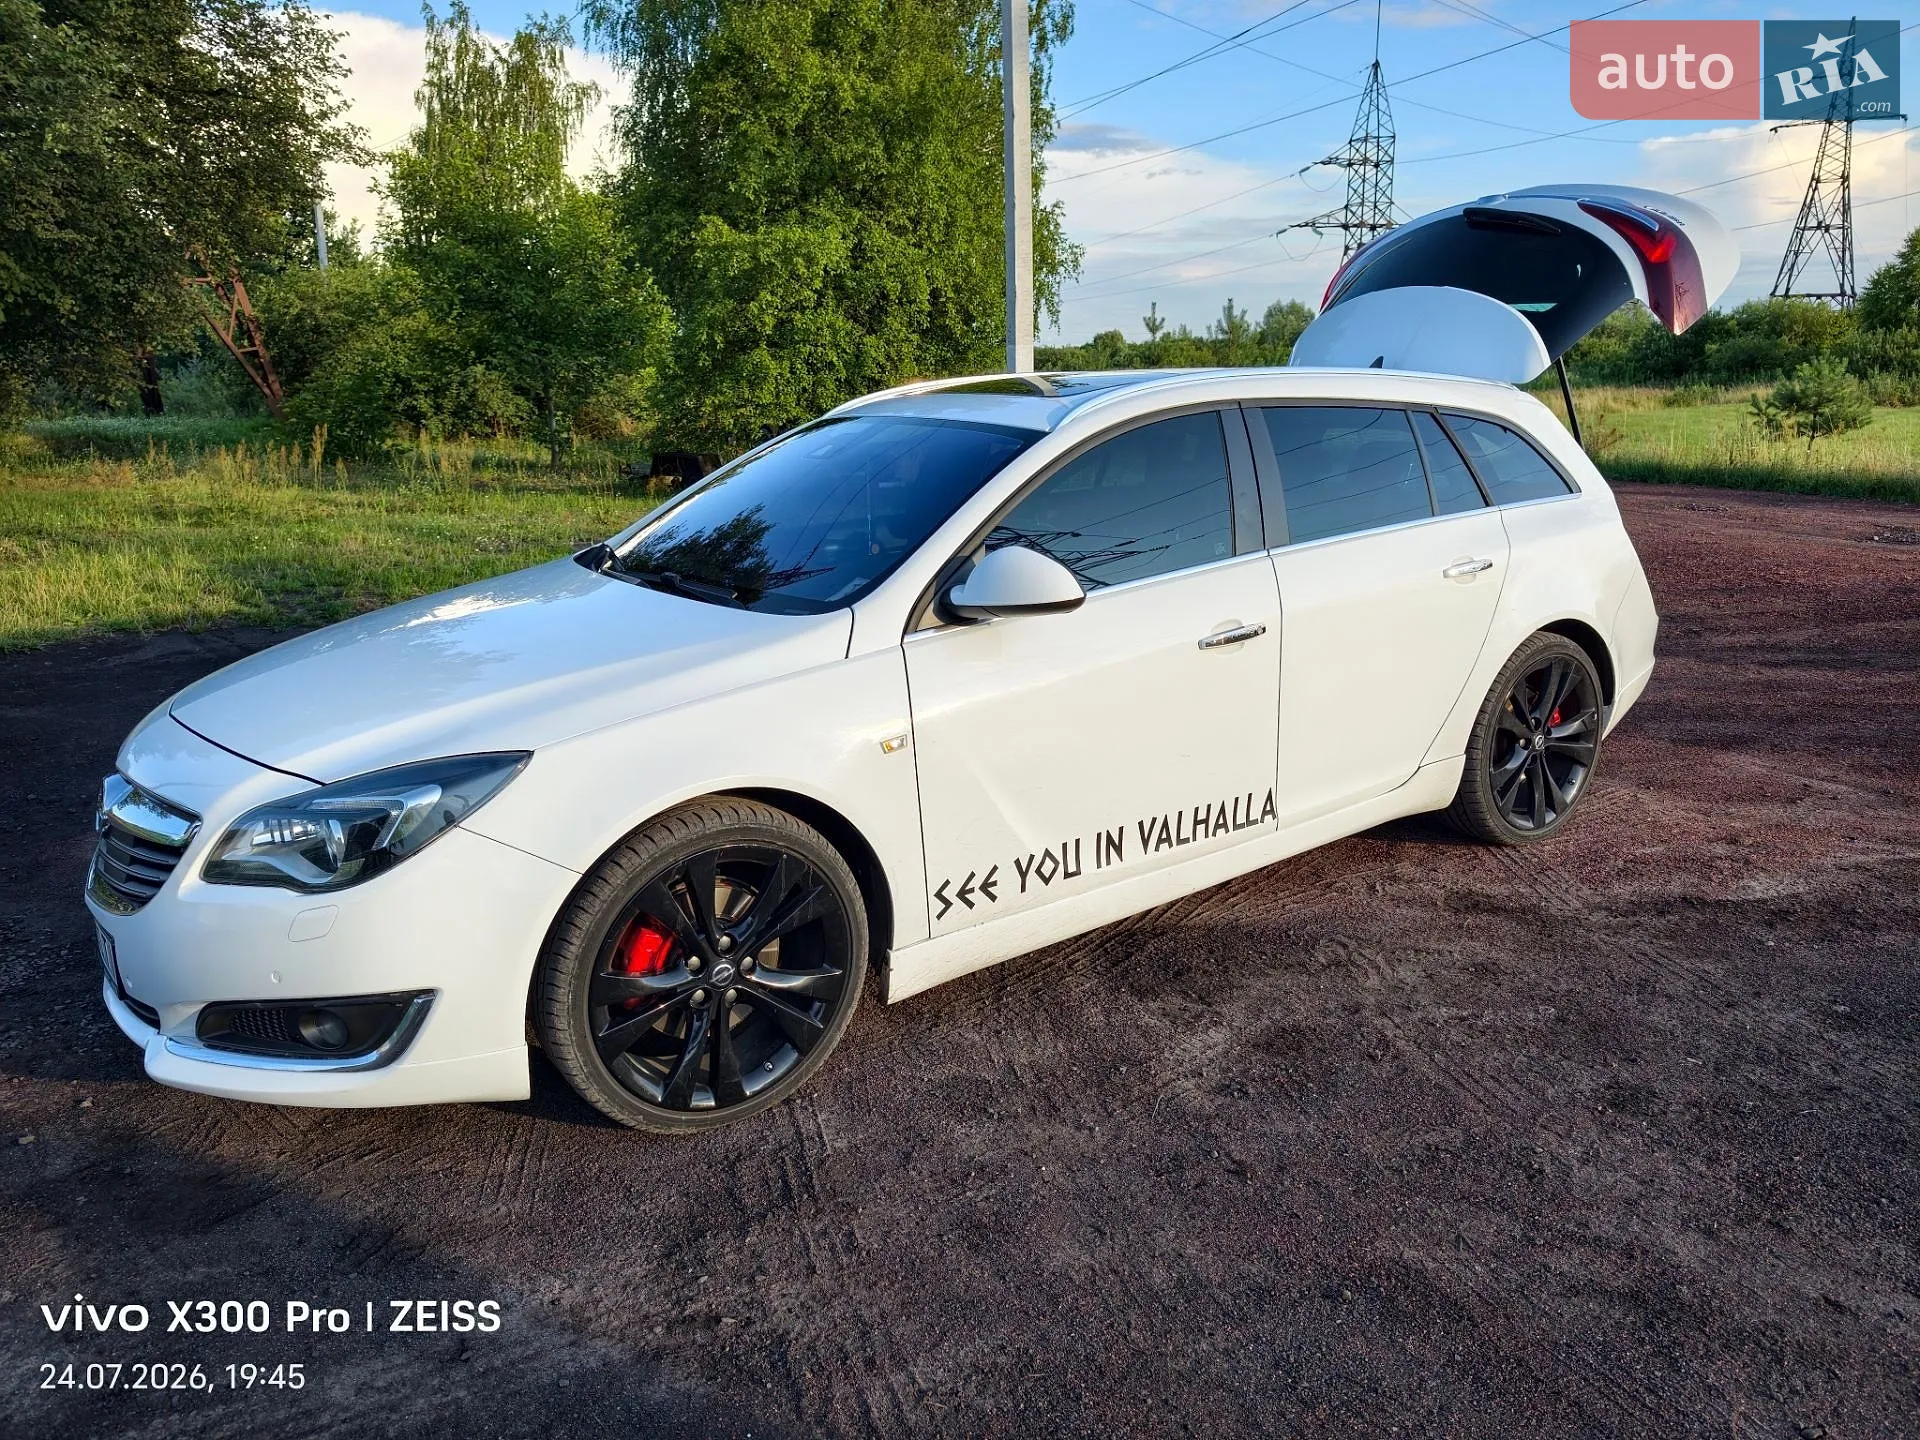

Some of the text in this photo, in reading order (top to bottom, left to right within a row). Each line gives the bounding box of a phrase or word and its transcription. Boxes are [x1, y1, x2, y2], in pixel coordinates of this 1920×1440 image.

[933, 787, 1277, 921] SEE YOU IN VALHALLA
